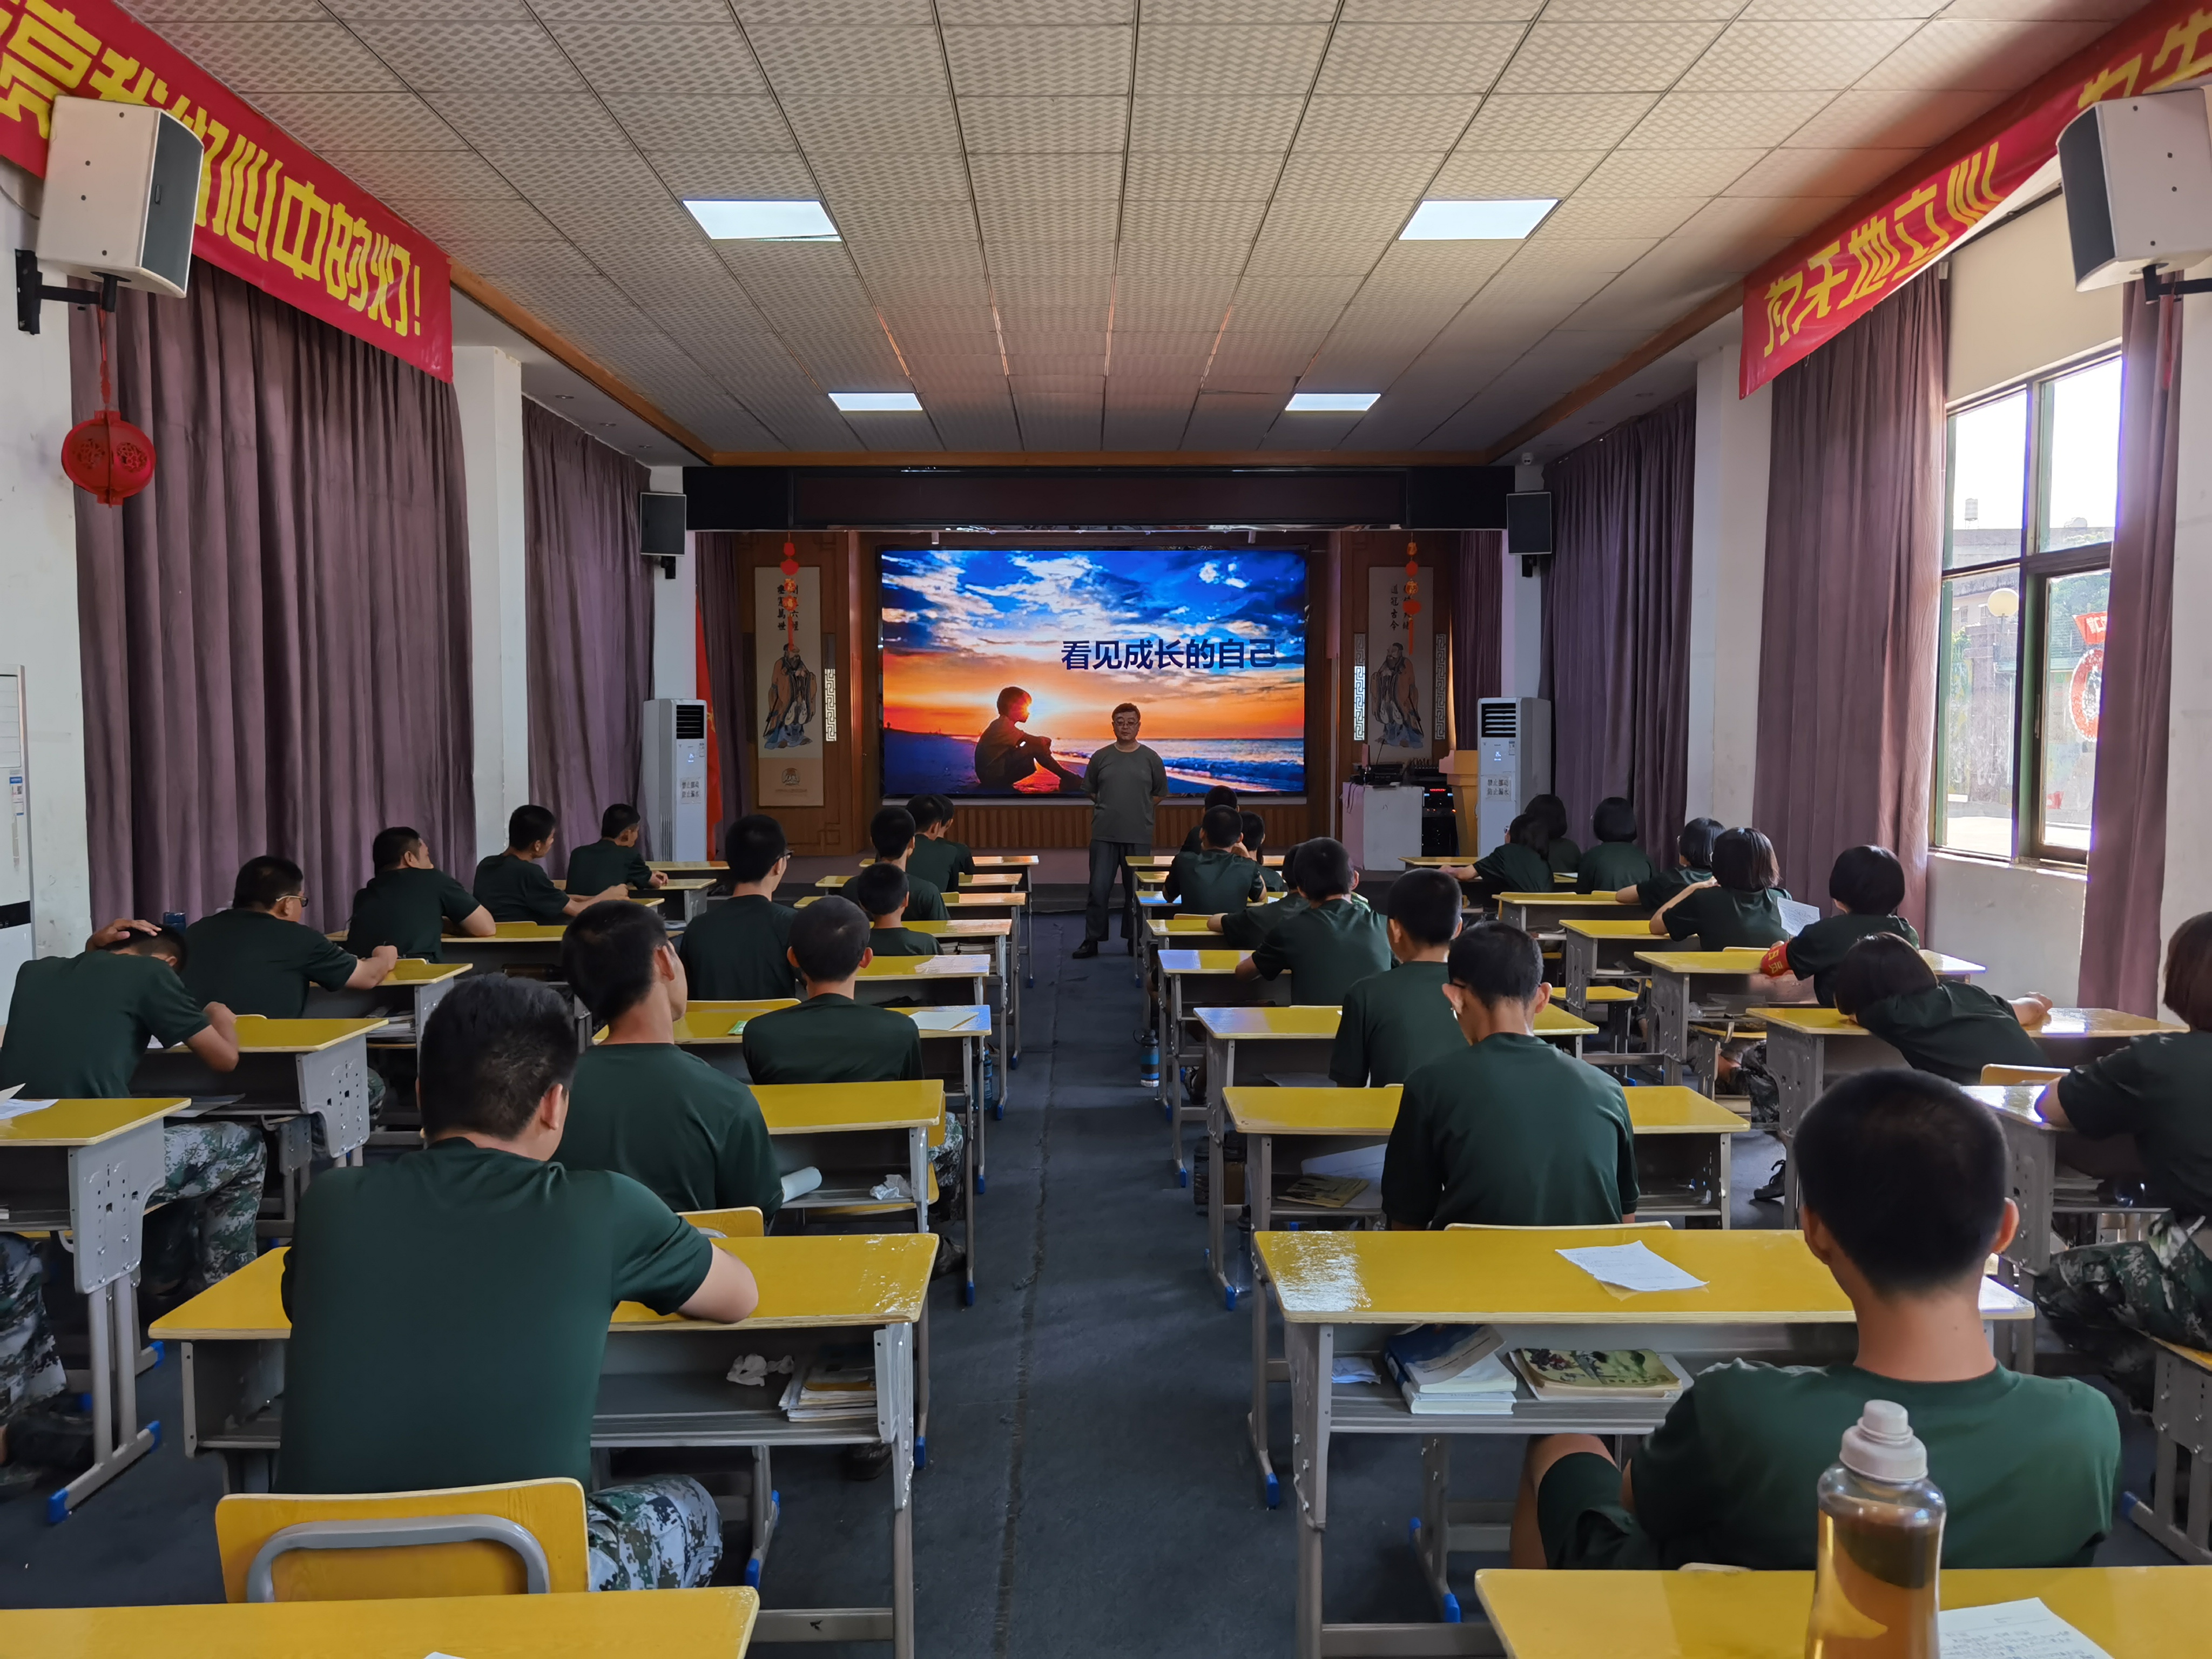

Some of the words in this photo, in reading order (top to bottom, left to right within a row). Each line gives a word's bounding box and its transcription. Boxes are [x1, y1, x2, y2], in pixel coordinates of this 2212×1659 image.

[1764, 142, 2005, 358] 为天地立心
[1062, 639, 1278, 670] 看见成长的自己
